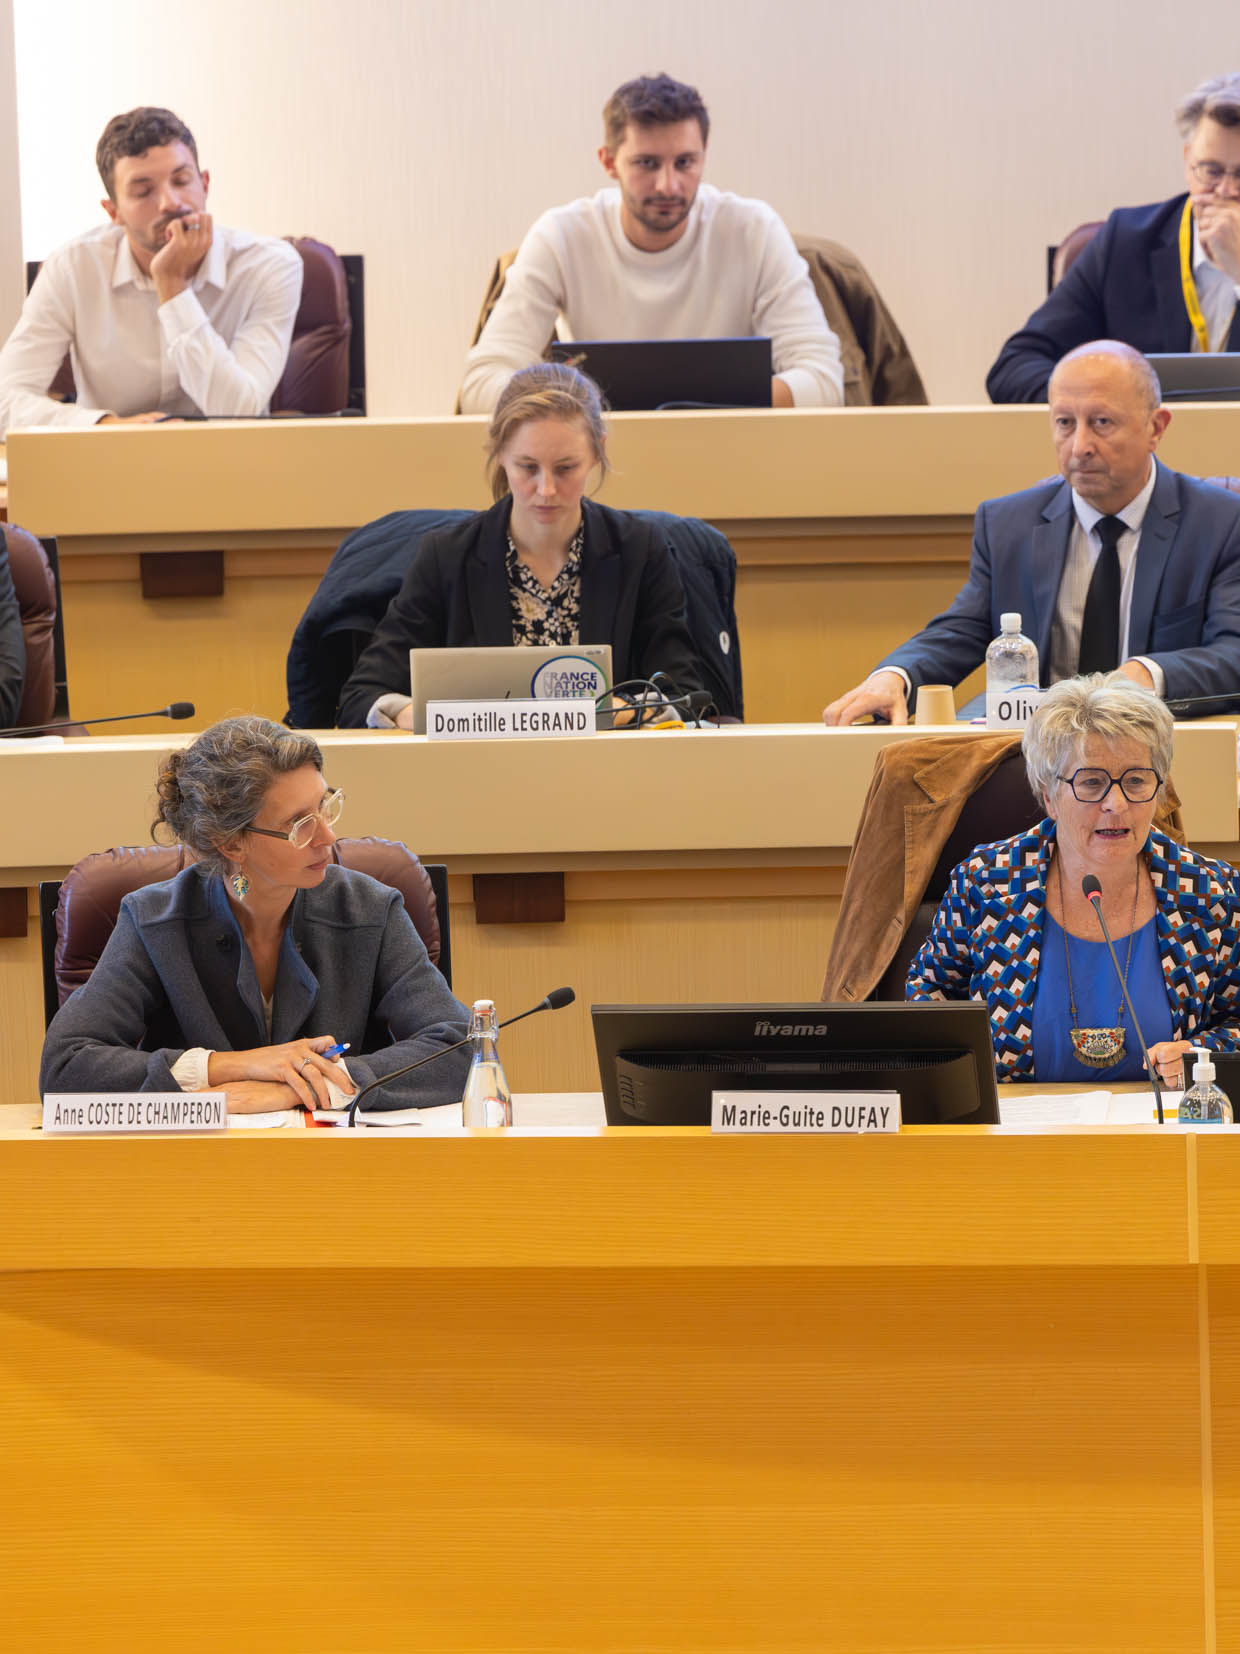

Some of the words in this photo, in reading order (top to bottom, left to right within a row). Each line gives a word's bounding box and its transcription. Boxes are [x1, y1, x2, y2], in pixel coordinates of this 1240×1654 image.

[544, 672, 597, 681] FRANCE
[544, 681, 597, 690] NATION
[435, 711, 506, 733] Domitille
[512, 711, 587, 732] LEGRAND
[754, 1021, 828, 1036] iiyama
[54, 1103, 84, 1125] Anne
[88, 1103, 123, 1125] COSTE
[128, 1103, 142, 1124] DE
[146, 1102, 222, 1125] CHAMPERON
[721, 1104, 825, 1127] Marie-Guite
[831, 1106, 890, 1129] DUFAY
